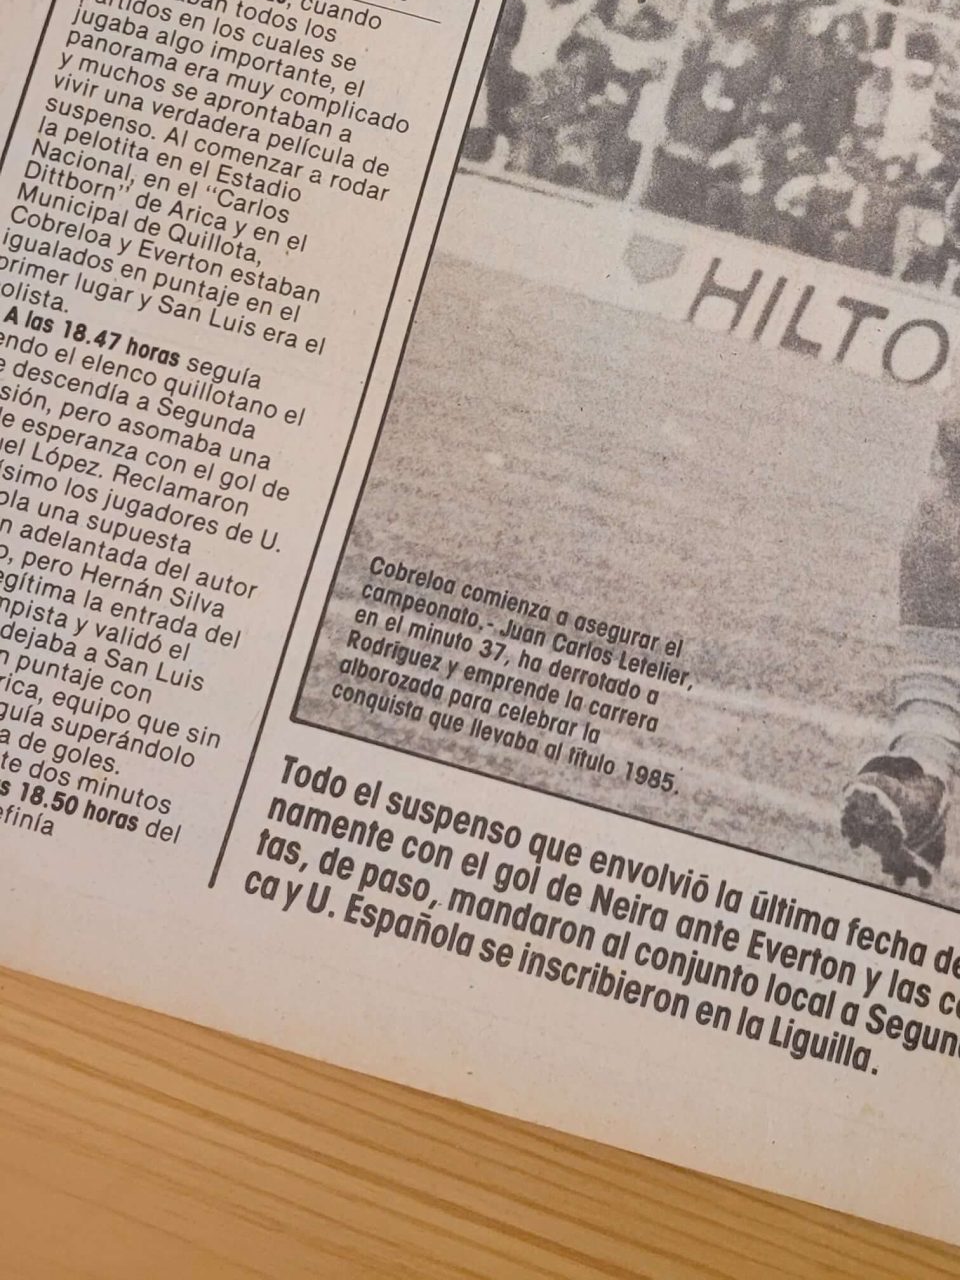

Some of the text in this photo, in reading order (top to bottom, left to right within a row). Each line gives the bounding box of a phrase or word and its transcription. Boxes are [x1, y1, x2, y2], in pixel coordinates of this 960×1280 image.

[10, 204, 321, 304] Cobreloa y Everton estaban
[354, 608, 660, 706] en el minuto 37, ha derrotado a
[369, 555, 684, 659] Cobreloa comienza a asegurar el
[498, 618, 547, 648] Juan
[551, 632, 615, 666] Carlos
[617, 650, 693, 692] Letelier,
[331, 683, 424, 722] conquista
[428, 710, 465, 733] que
[468, 717, 539, 755] llevaba
[543, 741, 564, 762] al
[567, 746, 616, 776] título
[338, 657, 601, 745] alborozada para celebrar la
[346, 628, 659, 733] Rodríguez y emprende la carrera
[267, 796, 395, 853] namente
[401, 835, 454, 871] con
[460, 850, 490, 880] el
[492, 862, 542, 895] gol
[546, 873, 583, 907] de
[589, 883, 669, 933] Neira
[675, 914, 740, 953] ante
[746, 928, 857, 987] Everton
[862, 966, 883, 999] y
[887, 968, 932, 1009] las
[280, 754, 348, 799] Todo
[353, 779, 383, 809] el
[385, 791, 522, 849] suspenso
[528, 832, 583, 867] que
[589, 850, 710, 904] envolvió
[714, 879, 744, 914] la
[749, 890, 841, 942] última
[845, 917, 928, 968] fecha
[244, 870, 878, 1076] ca y U. Española se inscribieron en la Liguilla.
[256, 828, 309, 873] tas,
[318, 846, 356, 881] de
[357, 861, 438, 911] paso,
[447, 887, 596, 951] mandaron
[601, 930, 632, 961] al
[634, 942, 760, 998] conjunto
[764, 972, 837, 1020] local
[840, 1001, 860, 1028] a
